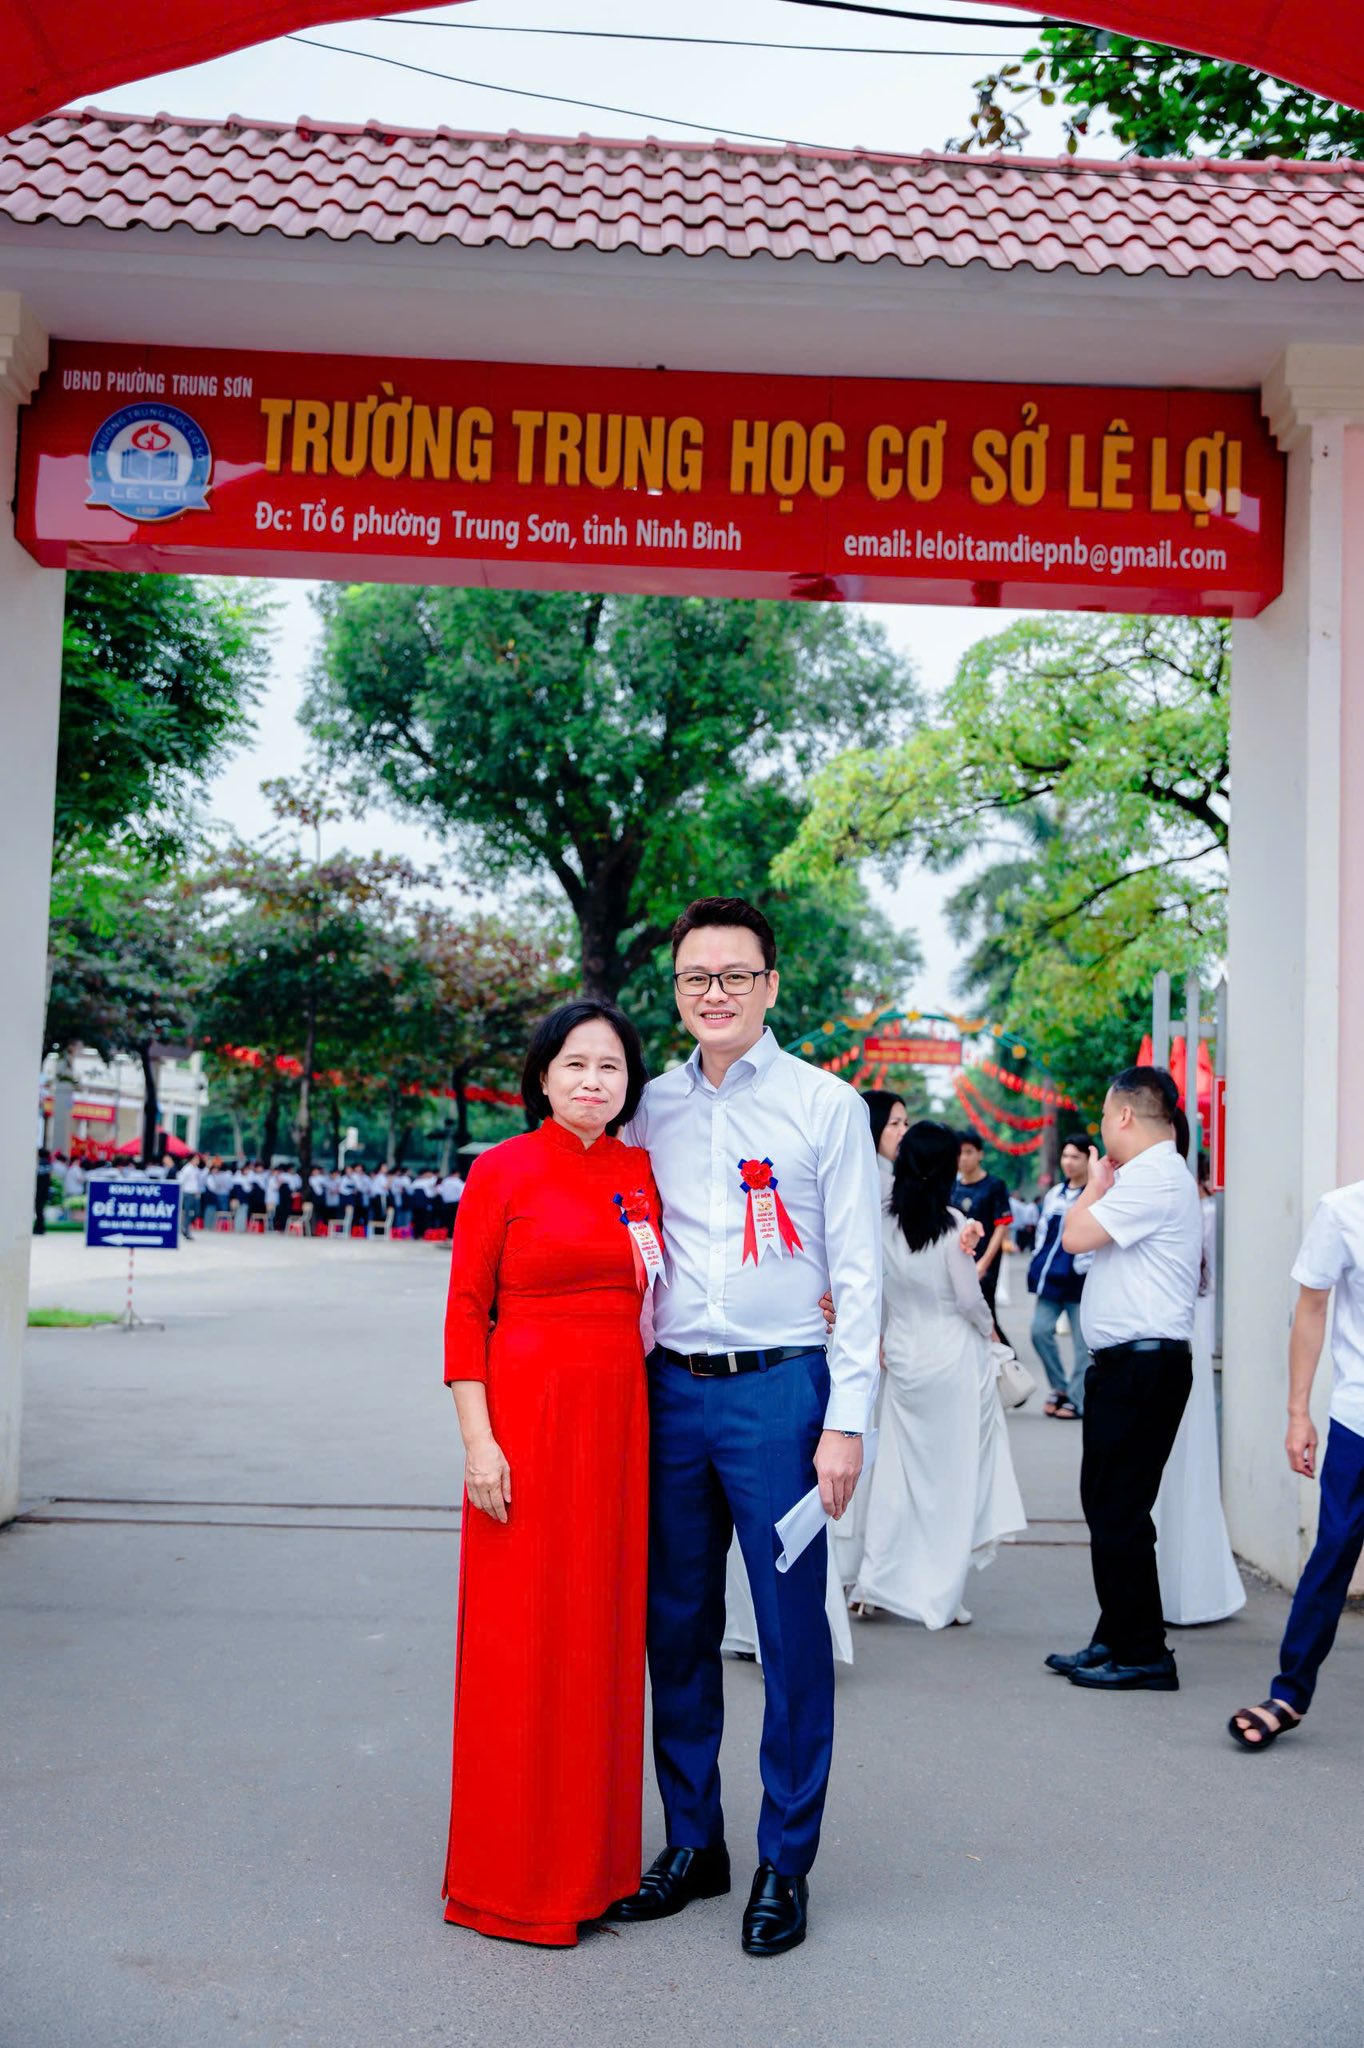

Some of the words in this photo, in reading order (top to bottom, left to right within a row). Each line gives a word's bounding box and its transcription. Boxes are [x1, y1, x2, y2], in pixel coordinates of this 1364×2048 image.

[63, 370, 101, 391] UBND
[106, 366, 165, 393] PHƯỜNG
[172, 374, 218, 397] TRUNG
[223, 376, 253, 398] SƠN
[126, 408, 165, 419] TRUNG
[260, 382, 494, 482] TRƯỜNG
[512, 410, 704, 495] TRUNG
[730, 420, 845, 513] HỌC
[867, 420, 947, 502] CƠ
[971, 402, 1049, 507] SỞ
[1069, 418, 1135, 510] LÊ
[1151, 431, 1242, 527] LỢI
[255, 501, 292, 531] Đc:
[301, 498, 327, 532] Tổ
[331, 506, 345, 533] 6
[353, 505, 440, 545] phường
[452, 510, 519, 549] Trung
[527, 514, 577, 549] Sơn,
[583, 515, 627, 546] tỉnh
[636, 518, 688, 549] Ninh
[692, 521, 741, 551] Bình
[844, 529, 912, 558] email:
[916, 530, 1227, 574] leloitamdiepnb@gmail.com
[109, 1184, 135, 1196] KHU
[136, 1184, 162, 1198] VỰC
[92, 1197, 116, 1217] ĐỂ
[117, 1202, 138, 1218] XE
[140, 1200, 176, 1219] MÁY
